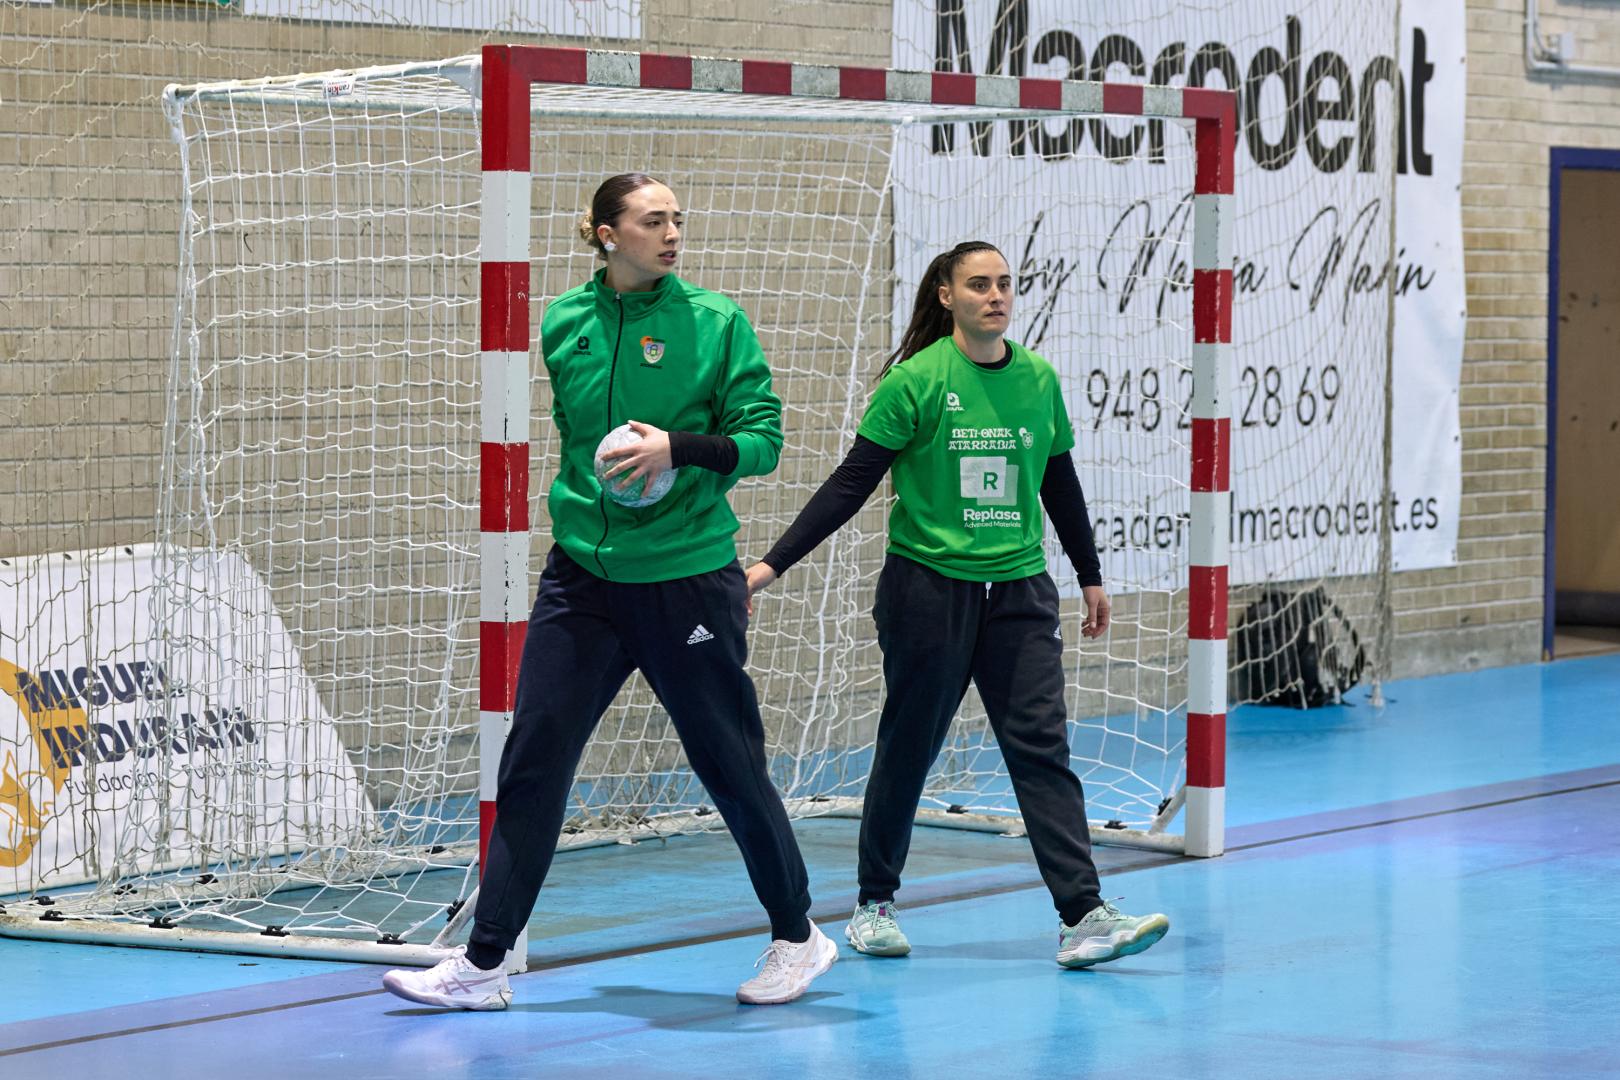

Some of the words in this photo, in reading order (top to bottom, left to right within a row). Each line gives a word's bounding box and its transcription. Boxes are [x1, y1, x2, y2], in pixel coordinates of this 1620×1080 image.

[1016, 210, 1080, 350] by
[1086, 367, 1162, 432] 948
[1241, 365, 1282, 428] 28
[1296, 364, 1340, 427] 69
[983, 471, 998, 491] R
[963, 507, 1021, 522] Replasa
[686, 633, 715, 645] adidas
[14, 660, 185, 713] MIGUEL
